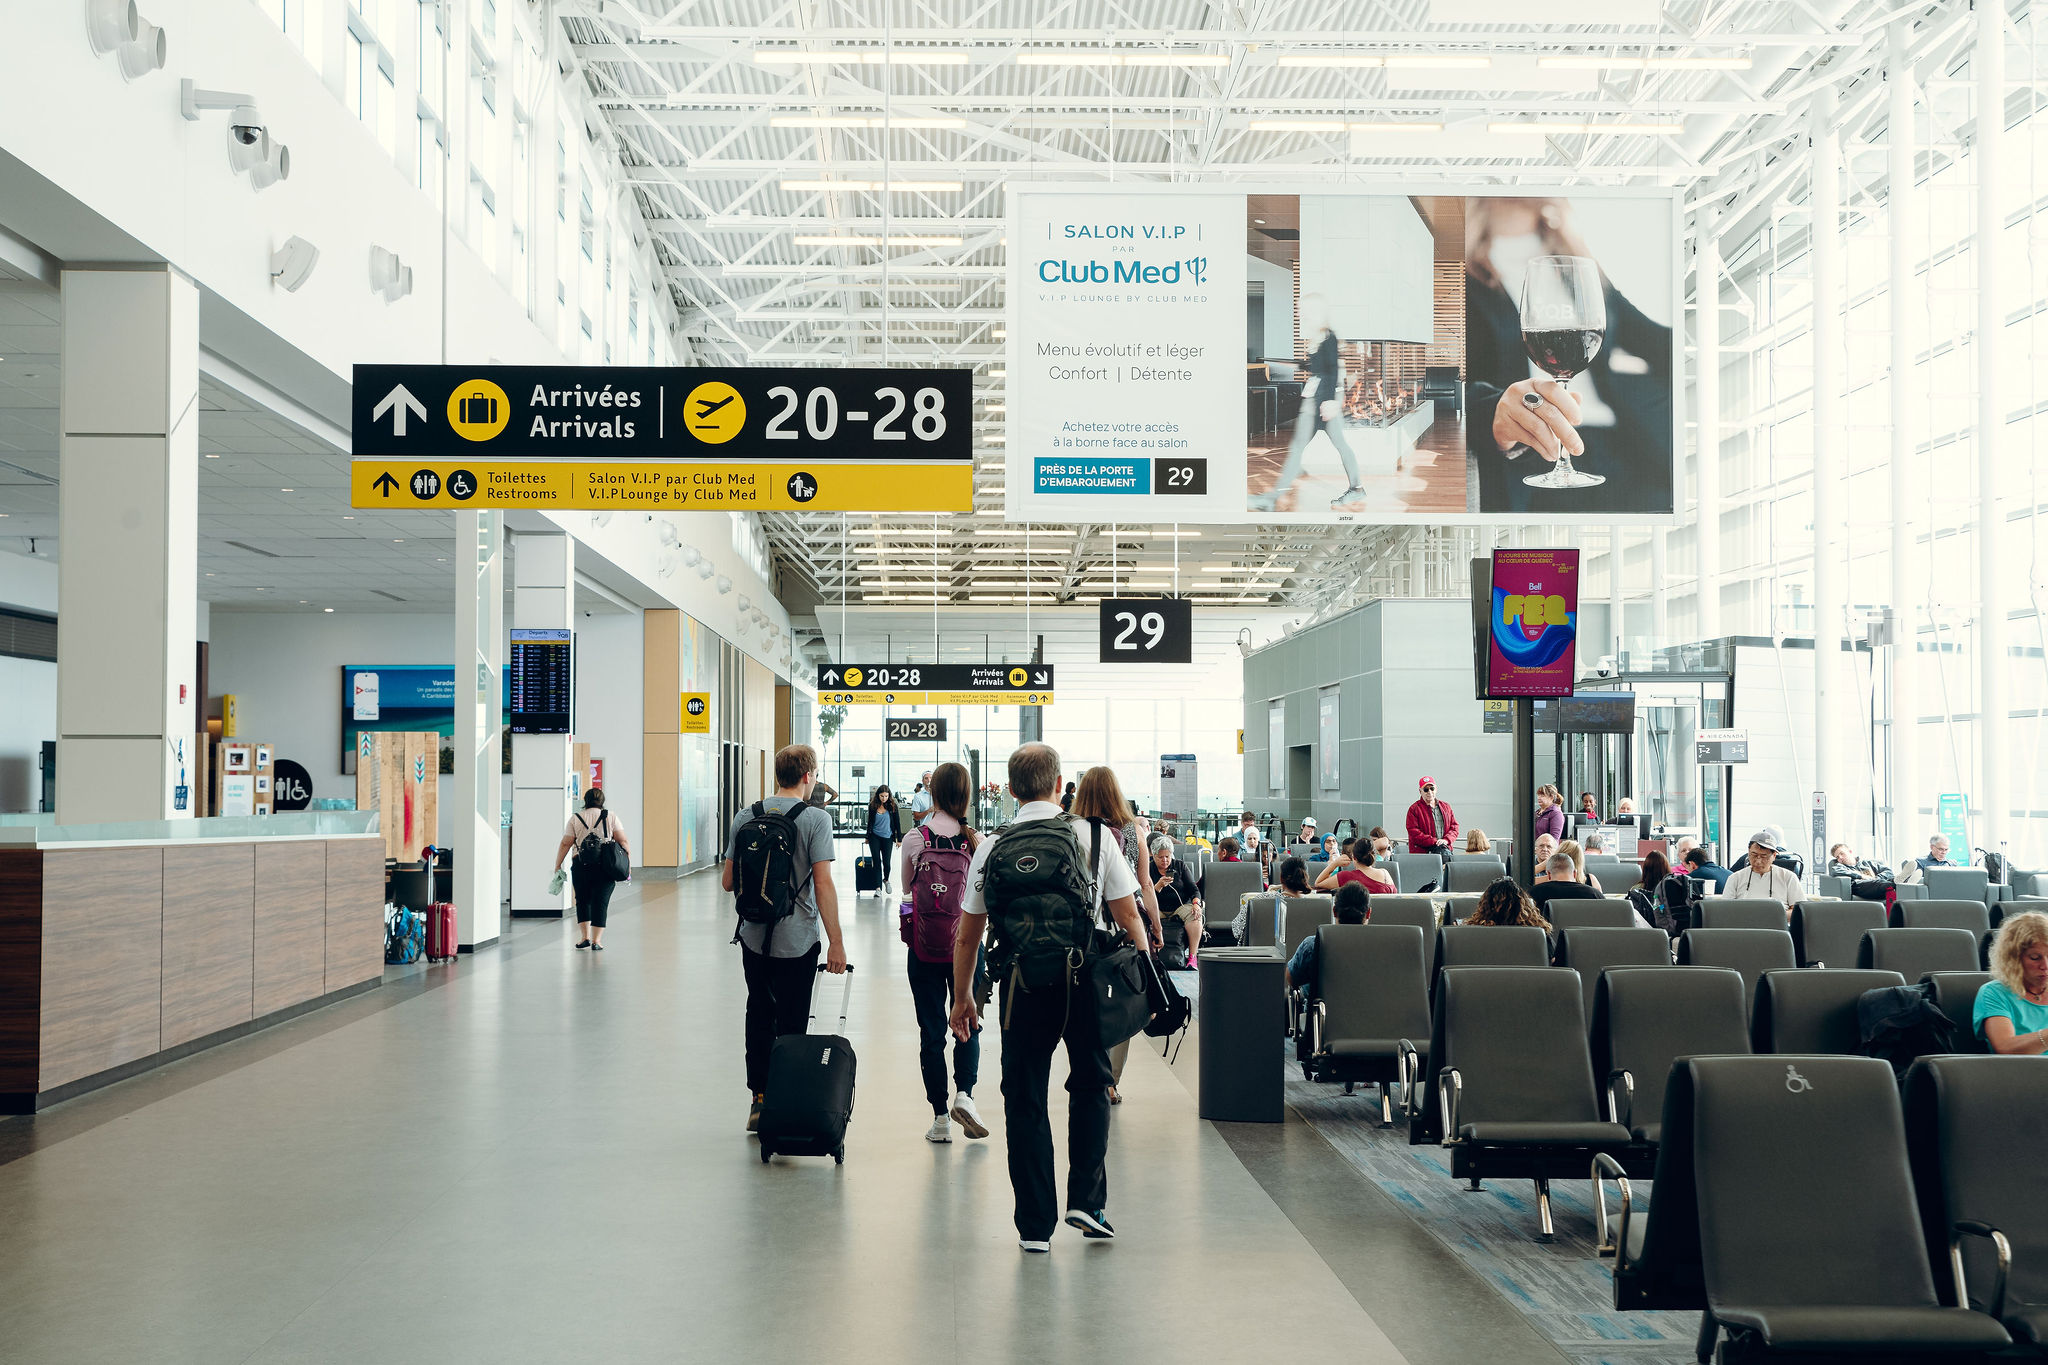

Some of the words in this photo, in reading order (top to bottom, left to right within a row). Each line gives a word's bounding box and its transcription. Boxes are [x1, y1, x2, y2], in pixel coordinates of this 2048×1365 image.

[1064, 225, 1134, 239] SALON
[1142, 225, 1186, 239] V.I.P
[1112, 245, 1135, 253] PAR
[1039, 259, 1108, 284] Club
[1114, 260, 1180, 284] Med
[1073, 295, 1120, 303] LOUNGE
[1127, 295, 1141, 303] BY
[1147, 295, 1177, 303] CLUB
[1183, 295, 1208, 303] MED
[1037, 342, 1081, 356] Menu
[1085, 342, 1142, 357] évolutif
[1146, 344, 1162, 357] et
[1166, 343, 1205, 361] léger
[1049, 366, 1108, 381] Confort
[1131, 366, 1192, 381] Détente
[529, 383, 641, 408] Arrivées
[765, 385, 947, 442] 20-28
[529, 414, 635, 439] Arrivals
[1062, 421, 1109, 432] Achetez
[1112, 422, 1142, 432] votre
[1144, 421, 1179, 433] accès
[1053, 436, 1060, 447] à
[1063, 437, 1073, 447] la
[1076, 437, 1110, 448] borne
[1112, 437, 1138, 448] face
[1140, 439, 1155, 448] au
[1158, 437, 1188, 448] salon
[1040, 462, 1066, 475] PRÈS
[1067, 465, 1081, 475] DE
[1082, 465, 1098, 475] LA
[1100, 465, 1134, 475] PORTE
[487, 472, 546, 484] Toilettes
[588, 472, 626, 484] Salon
[631, 472, 661, 484] V.I.P
[666, 475, 688, 488] par
[693, 473, 723, 485] Club
[728, 473, 755, 485] Med
[1040, 477, 1137, 488] D'EMBARQUEMENT
[1167, 466, 1194, 486] 29
[487, 487, 557, 499] Restrooms
[673, 489, 689, 503] by
[694, 489, 724, 500] Club
[729, 489, 756, 500] Med
[1528, 582, 1542, 591] Bell
[1113, 611, 1165, 650] 29
[867, 669, 921, 686] 20-28
[971, 668, 1004, 678] Arrivées
[972, 677, 1004, 686] Arrivals
[1490, 702, 1502, 710] 29
[889, 721, 938, 738] 20-28
[820, 1047, 831, 1065] THULE
